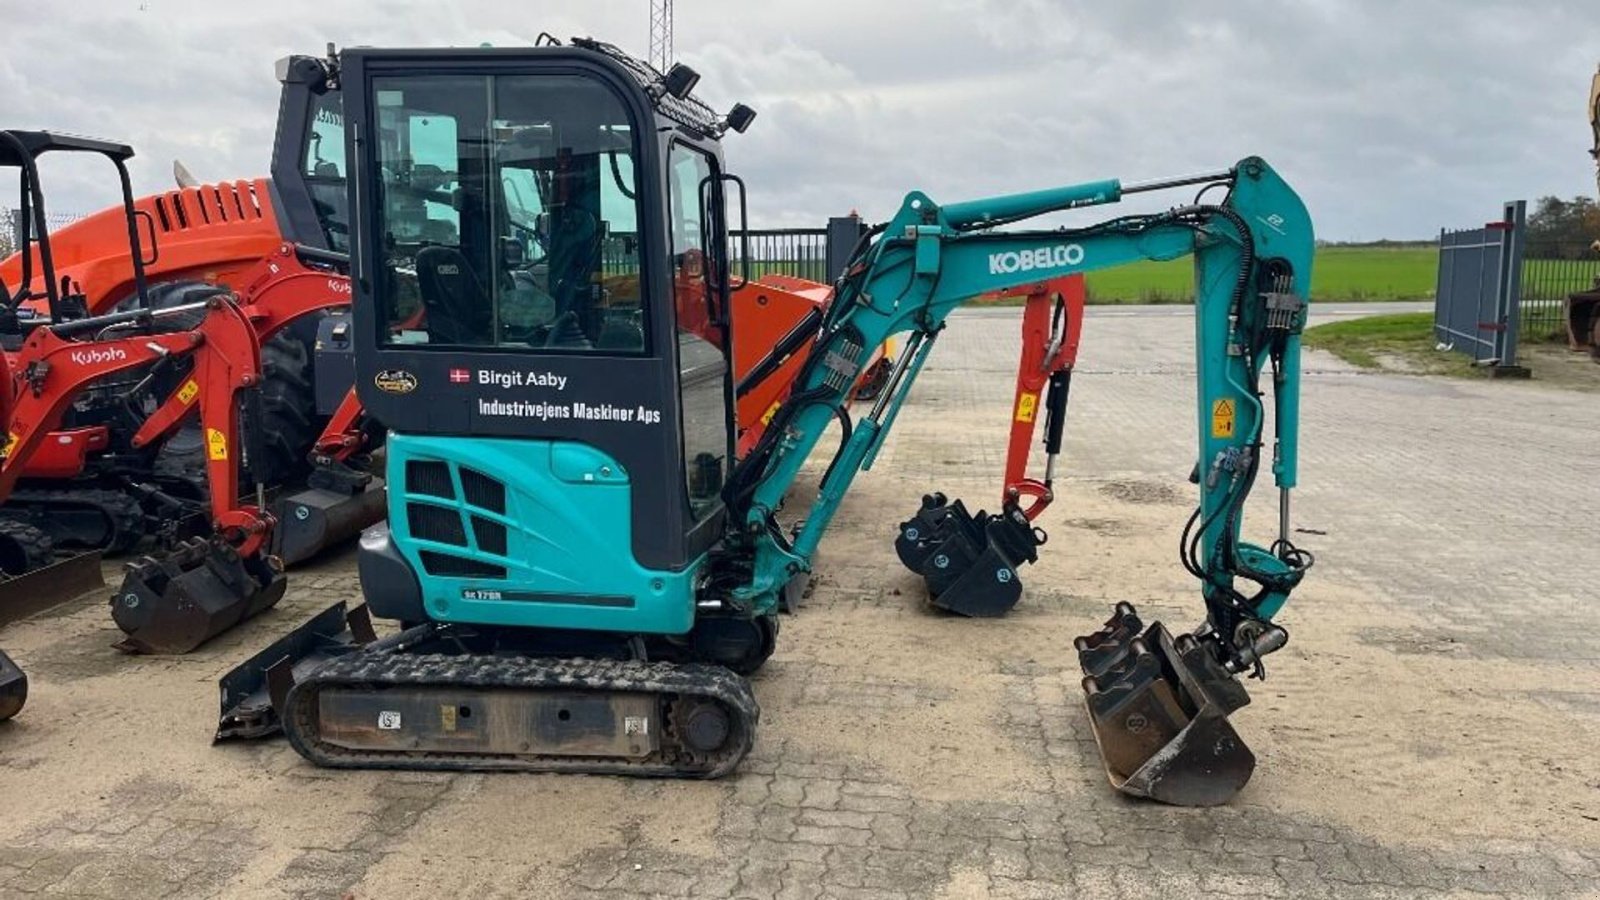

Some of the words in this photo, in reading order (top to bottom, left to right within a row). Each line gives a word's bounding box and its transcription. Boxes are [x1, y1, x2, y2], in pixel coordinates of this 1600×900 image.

[989, 244, 1084, 274] KOBELCO
[72, 347, 126, 365] Kubota
[478, 370, 522, 388] Birgit
[525, 372, 567, 390] Aaby
[479, 399, 570, 421] Industrivejens
[573, 403, 634, 421] Maskiner
[636, 406, 661, 424] Aps
